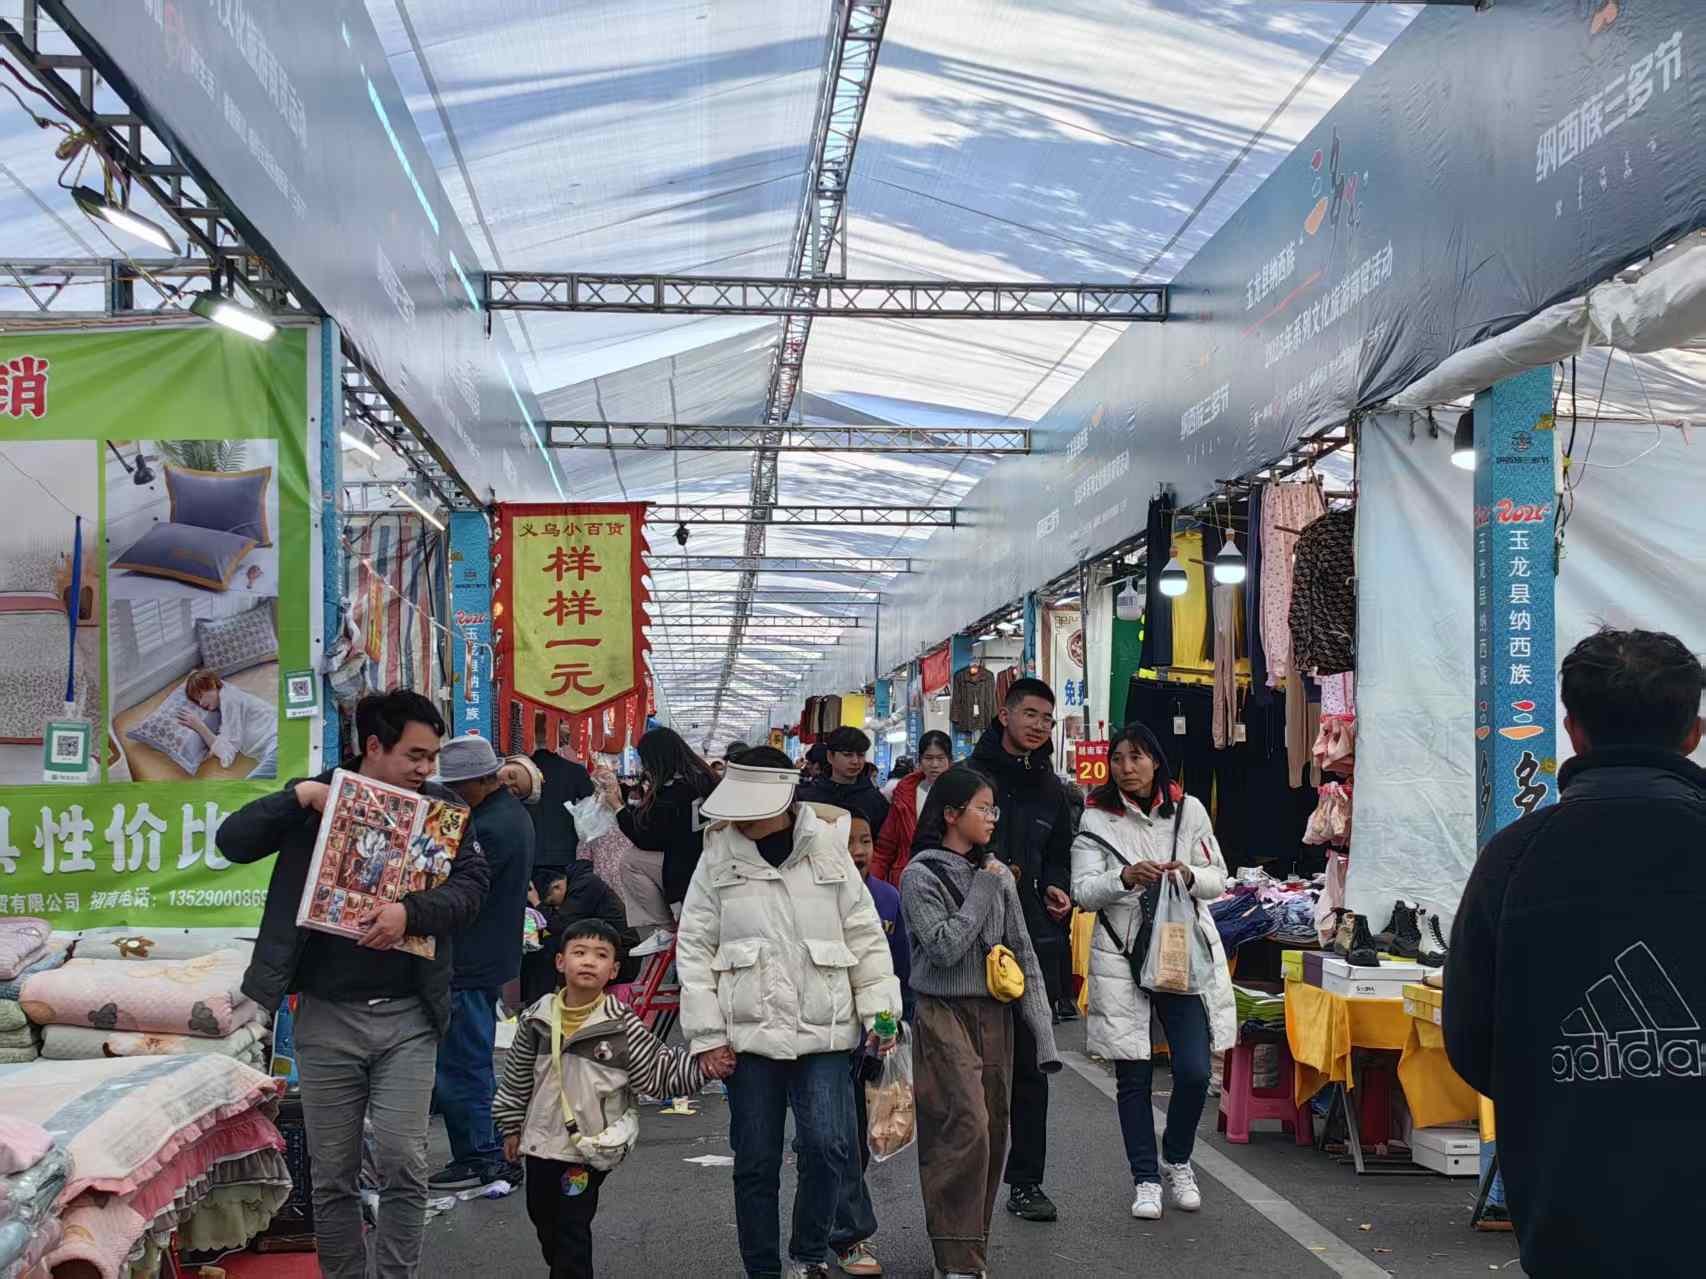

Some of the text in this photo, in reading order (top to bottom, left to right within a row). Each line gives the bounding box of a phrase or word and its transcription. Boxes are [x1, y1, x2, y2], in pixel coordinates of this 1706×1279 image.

[1536, 31, 1683, 184] 纳西族三多节
[519, 522, 625, 537] 义乌小百货
[542, 545, 605, 697] 样样一元
[1508, 530, 1533, 685] 玉龙县纳西族
[1079, 761, 1107, 780] 20
[1551, 1029, 1706, 1082] adida
